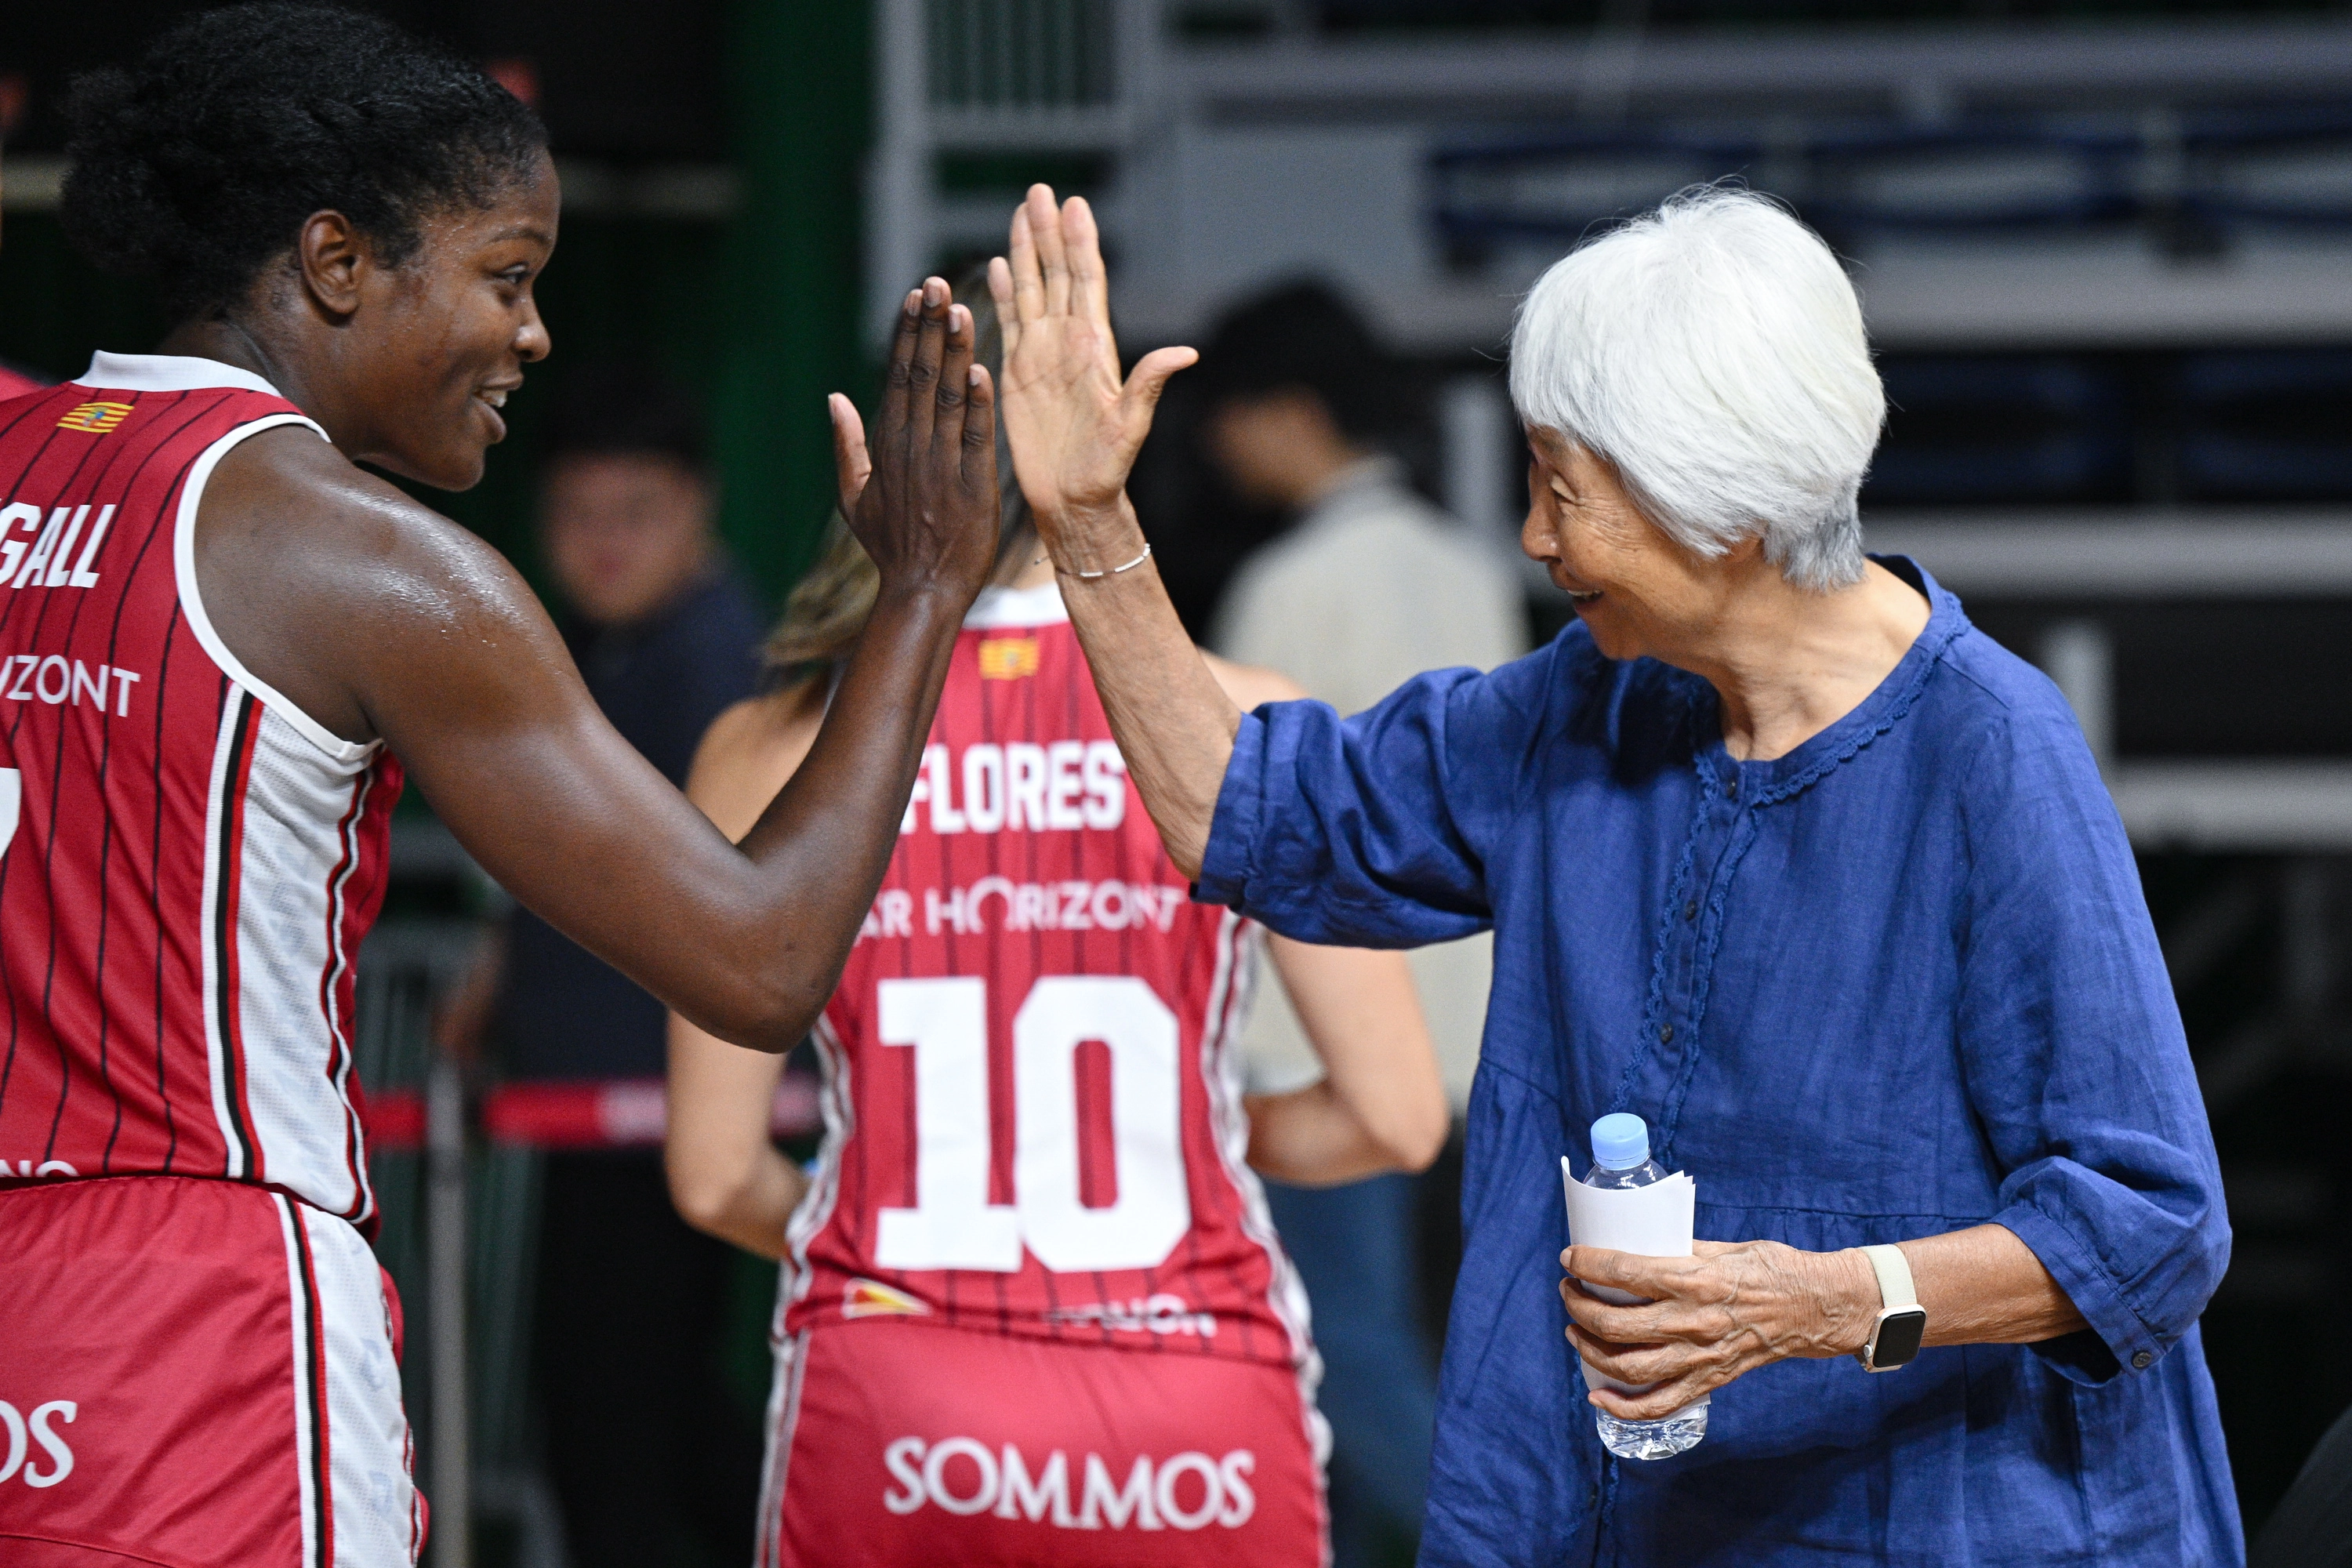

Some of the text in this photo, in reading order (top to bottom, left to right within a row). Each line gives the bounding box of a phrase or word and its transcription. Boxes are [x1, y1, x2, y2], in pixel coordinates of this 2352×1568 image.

[0, 500, 117, 589] GALL
[924, 875, 1187, 935] HORIZONT
[874, 975, 1192, 1274] 10
[883, 1435, 1256, 1531] SOMMOS
